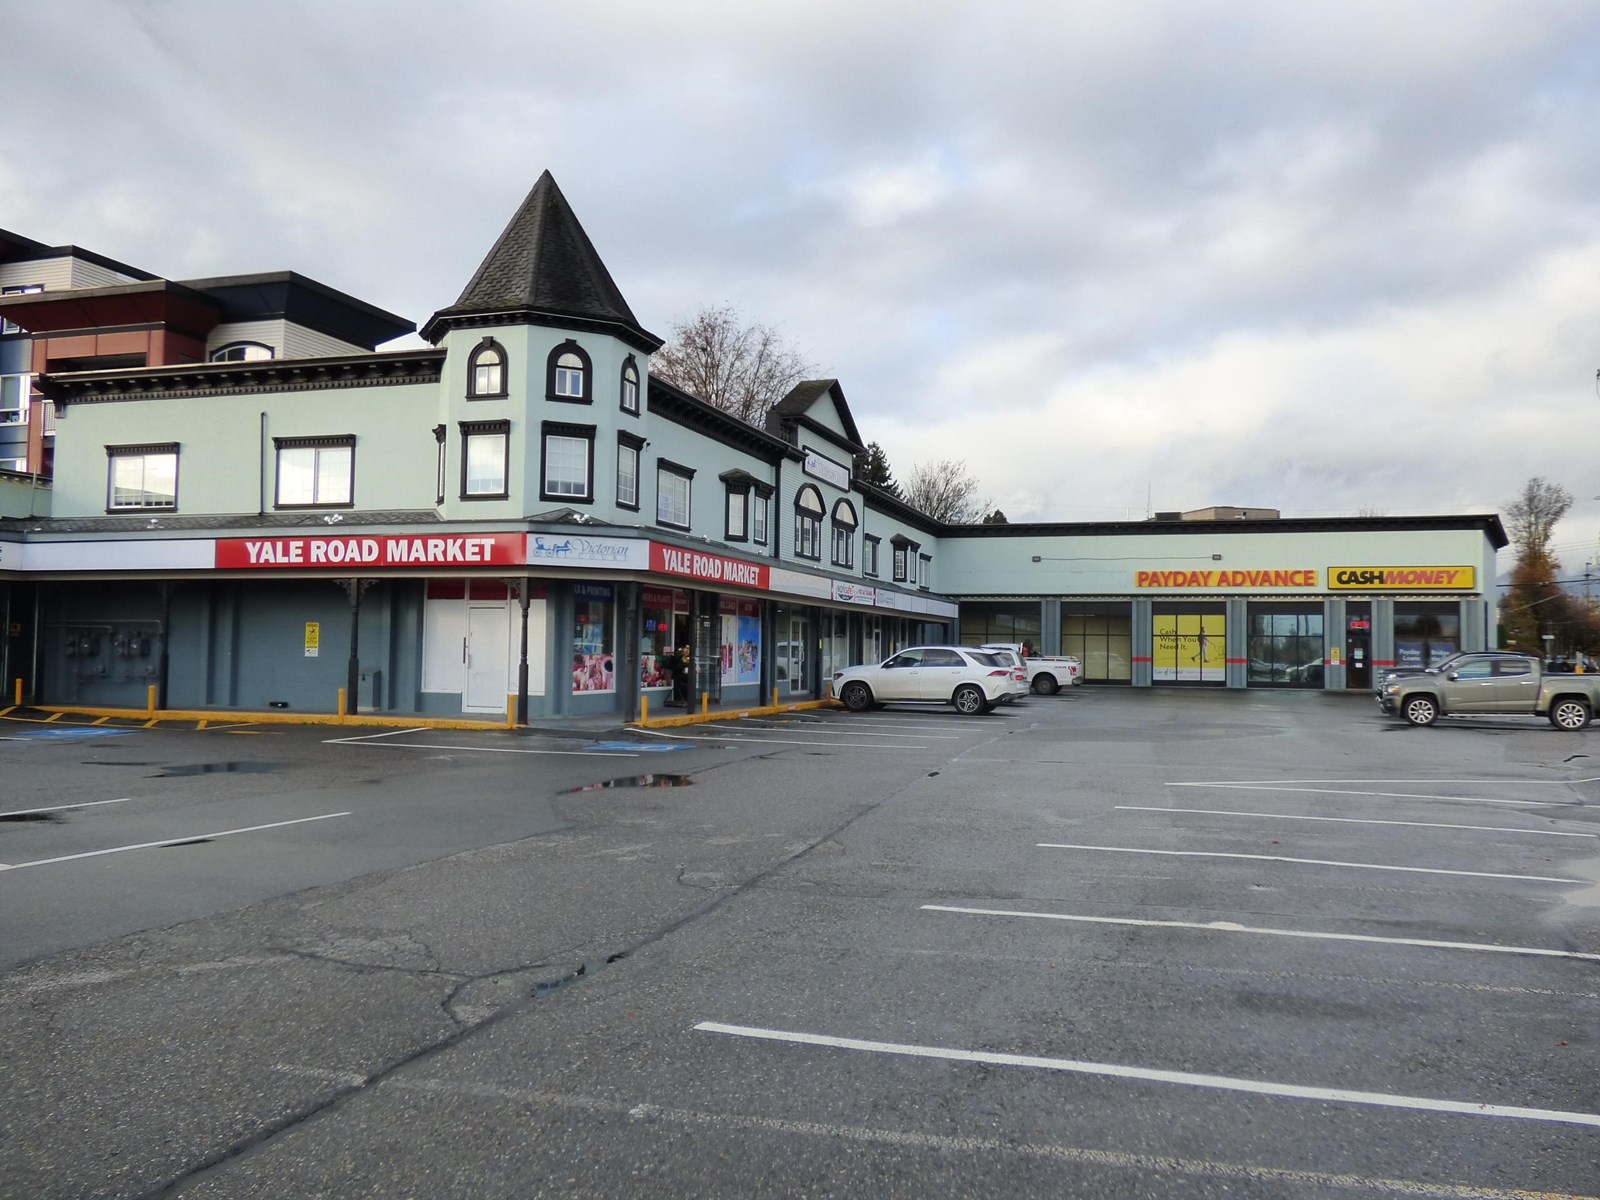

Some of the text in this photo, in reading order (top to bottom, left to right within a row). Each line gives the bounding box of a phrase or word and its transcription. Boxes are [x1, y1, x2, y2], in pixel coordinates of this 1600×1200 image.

[246, 538, 495, 563] YALE ROAD MARKET
[572, 538, 628, 555] Victorian
[662, 548, 759, 586] YALE ROAD MARKET
[1138, 570, 1315, 587] PAYDAY ADVANCE
